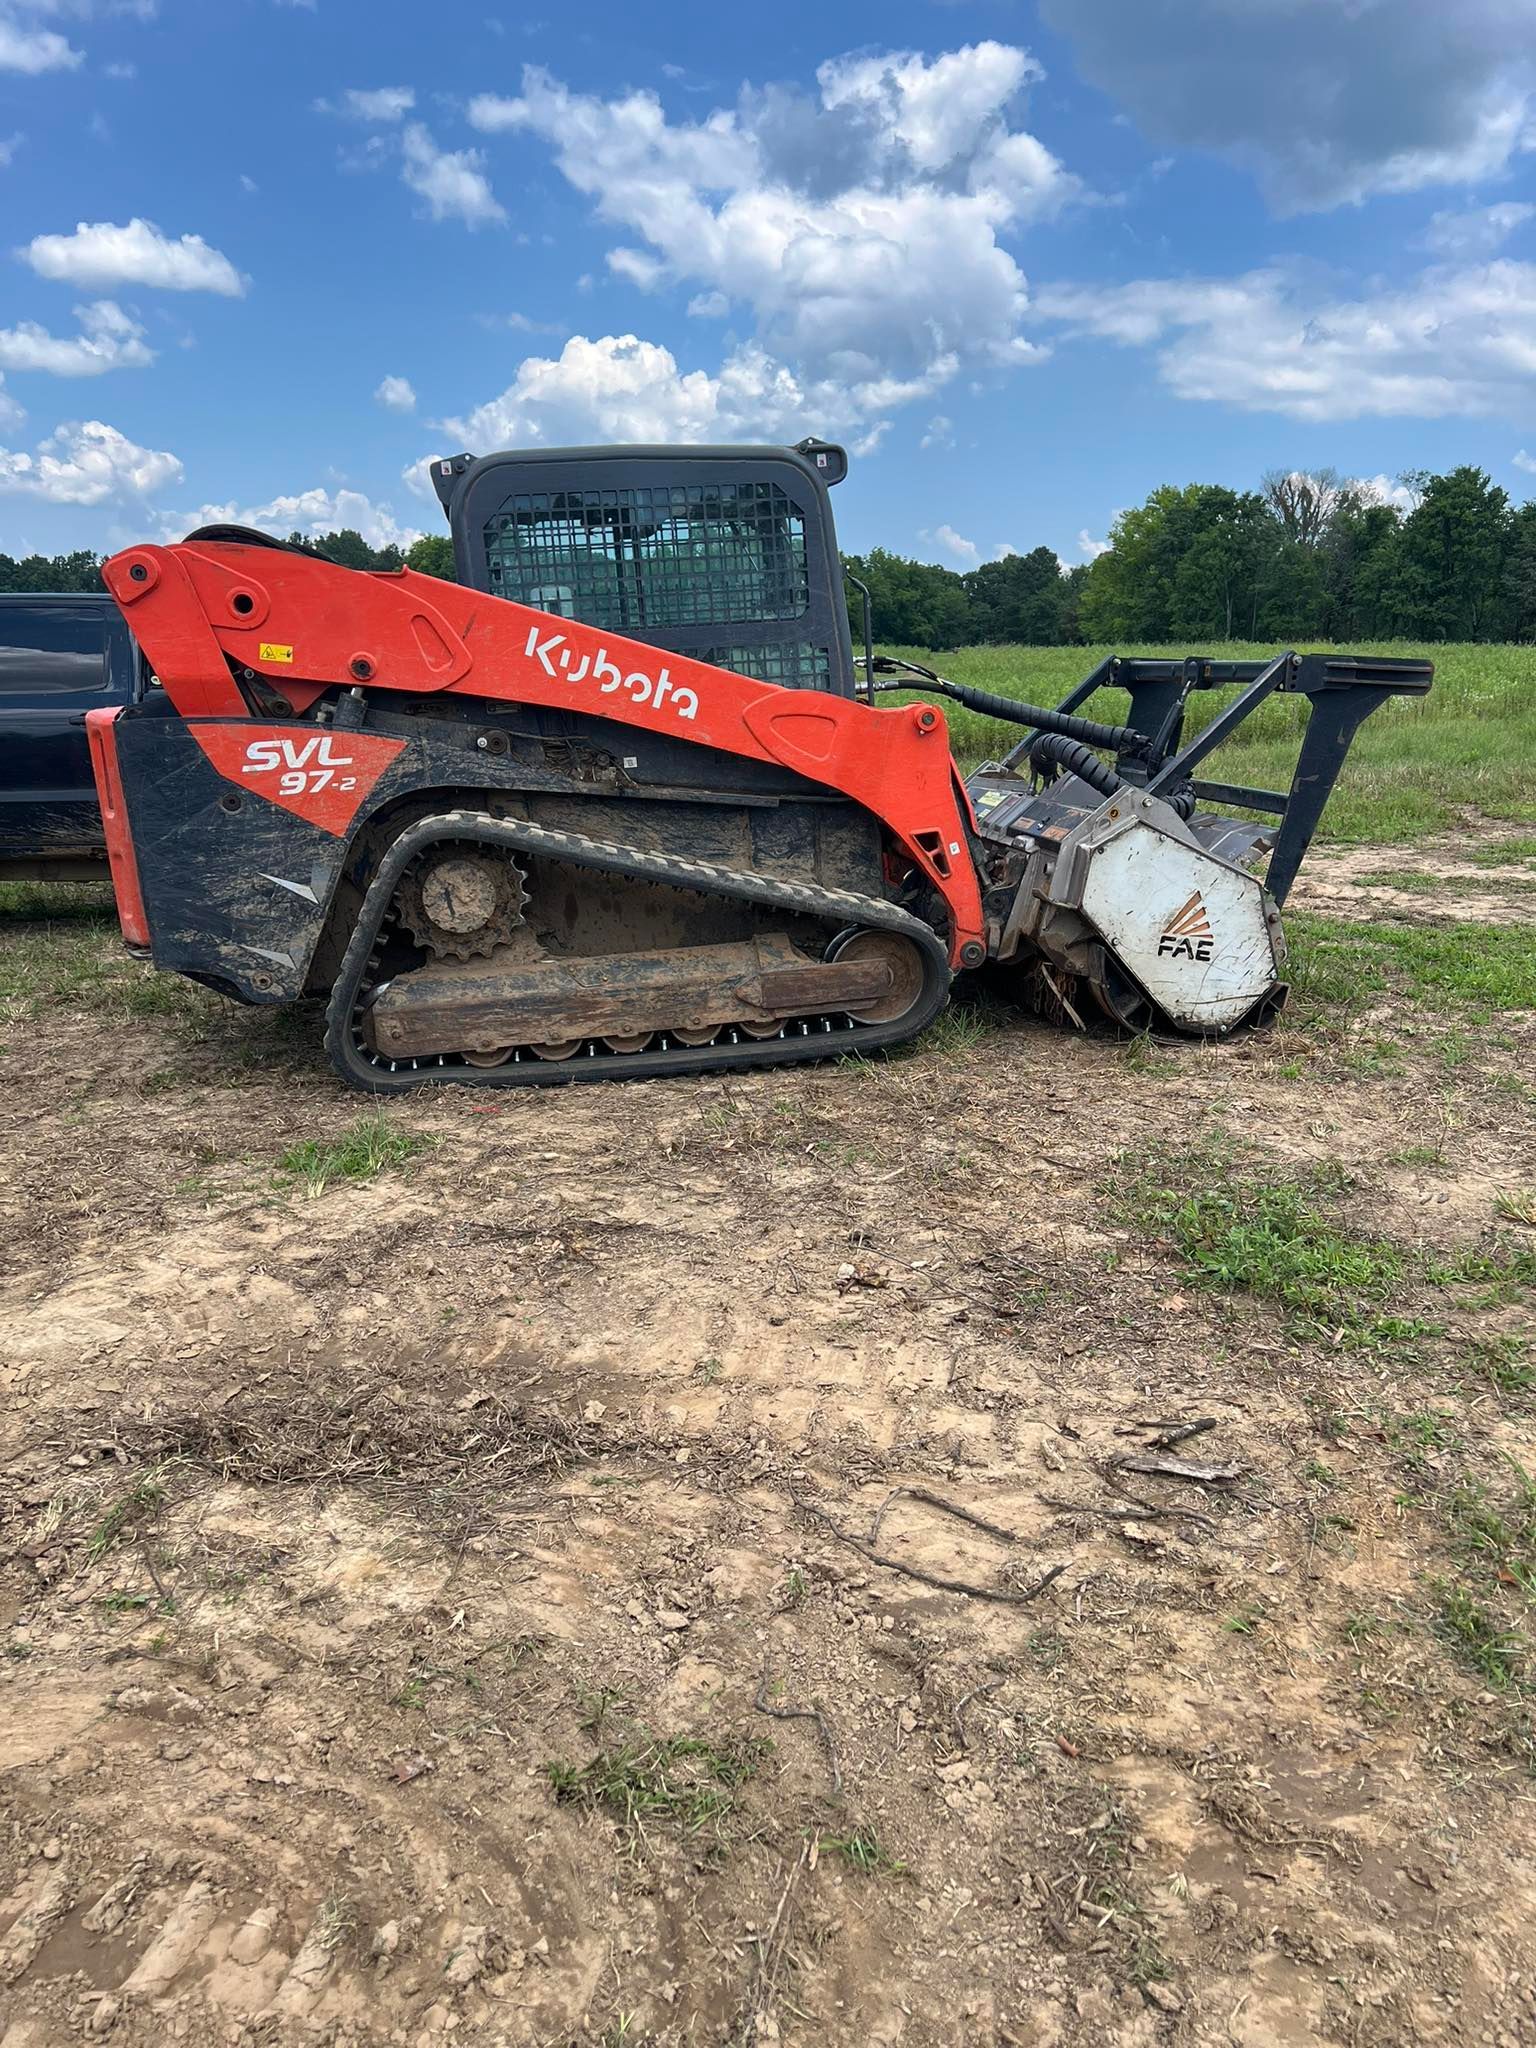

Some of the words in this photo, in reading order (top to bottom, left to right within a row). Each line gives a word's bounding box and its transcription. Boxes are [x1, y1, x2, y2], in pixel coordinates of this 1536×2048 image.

[525, 626, 699, 720] Kubota
[242, 736, 353, 772] SVL
[279, 770, 357, 796] 97-2
[1157, 935, 1214, 962] FAE
